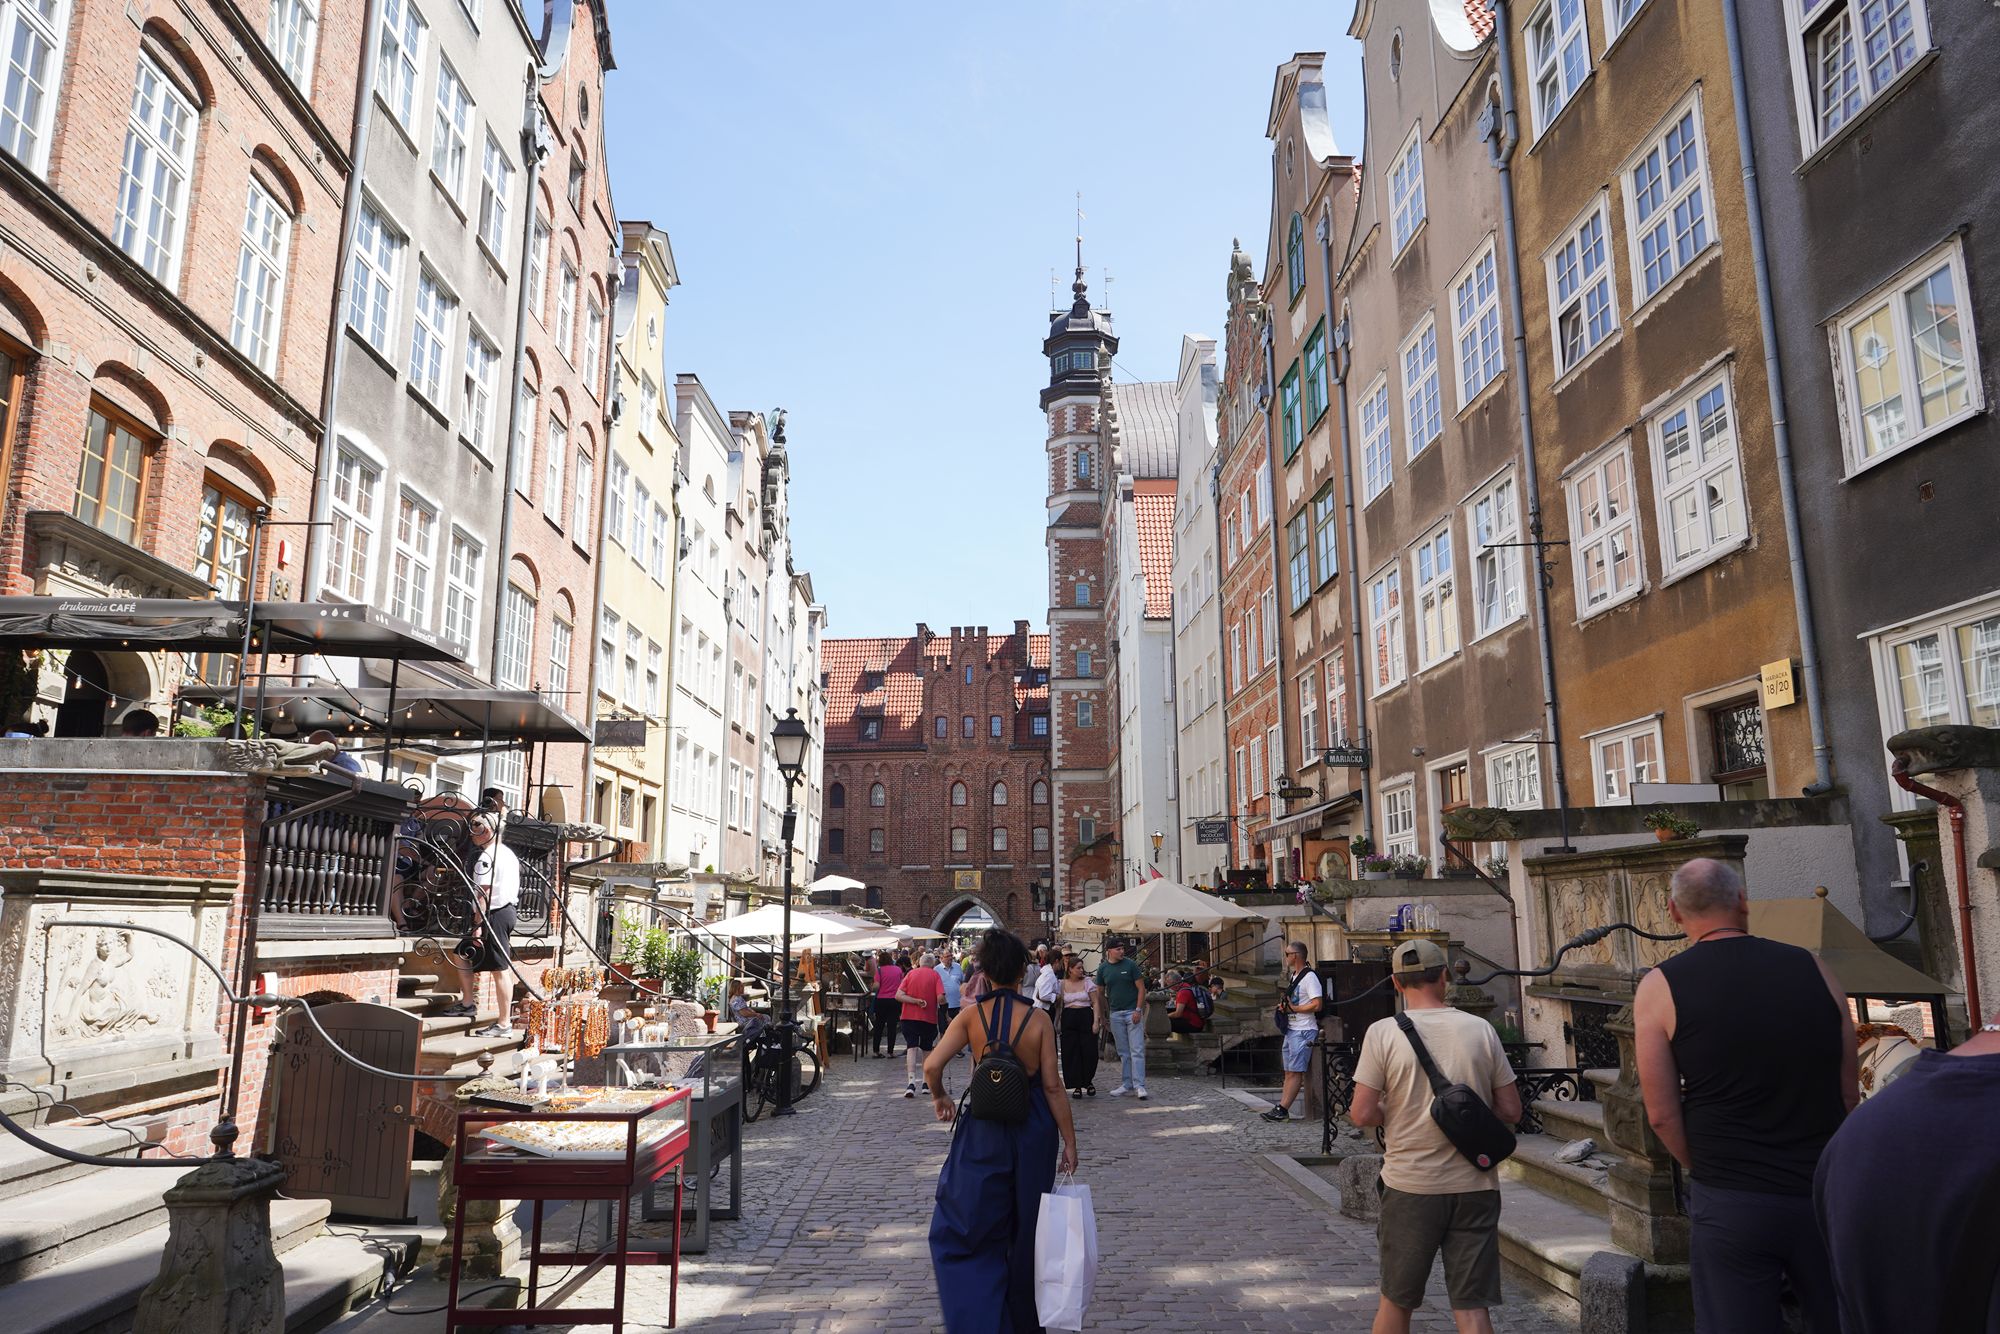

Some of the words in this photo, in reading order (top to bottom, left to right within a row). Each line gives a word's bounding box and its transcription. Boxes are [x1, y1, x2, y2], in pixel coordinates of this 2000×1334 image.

[59, 601, 108, 612] drukarnia
[109, 602, 136, 612] CAFÉ
[1766, 680, 1789, 695] 18/20
[1329, 755, 1363, 763] MARIACKA
[1088, 915, 1110, 925] Amber
[1165, 918, 1193, 928] Amber
